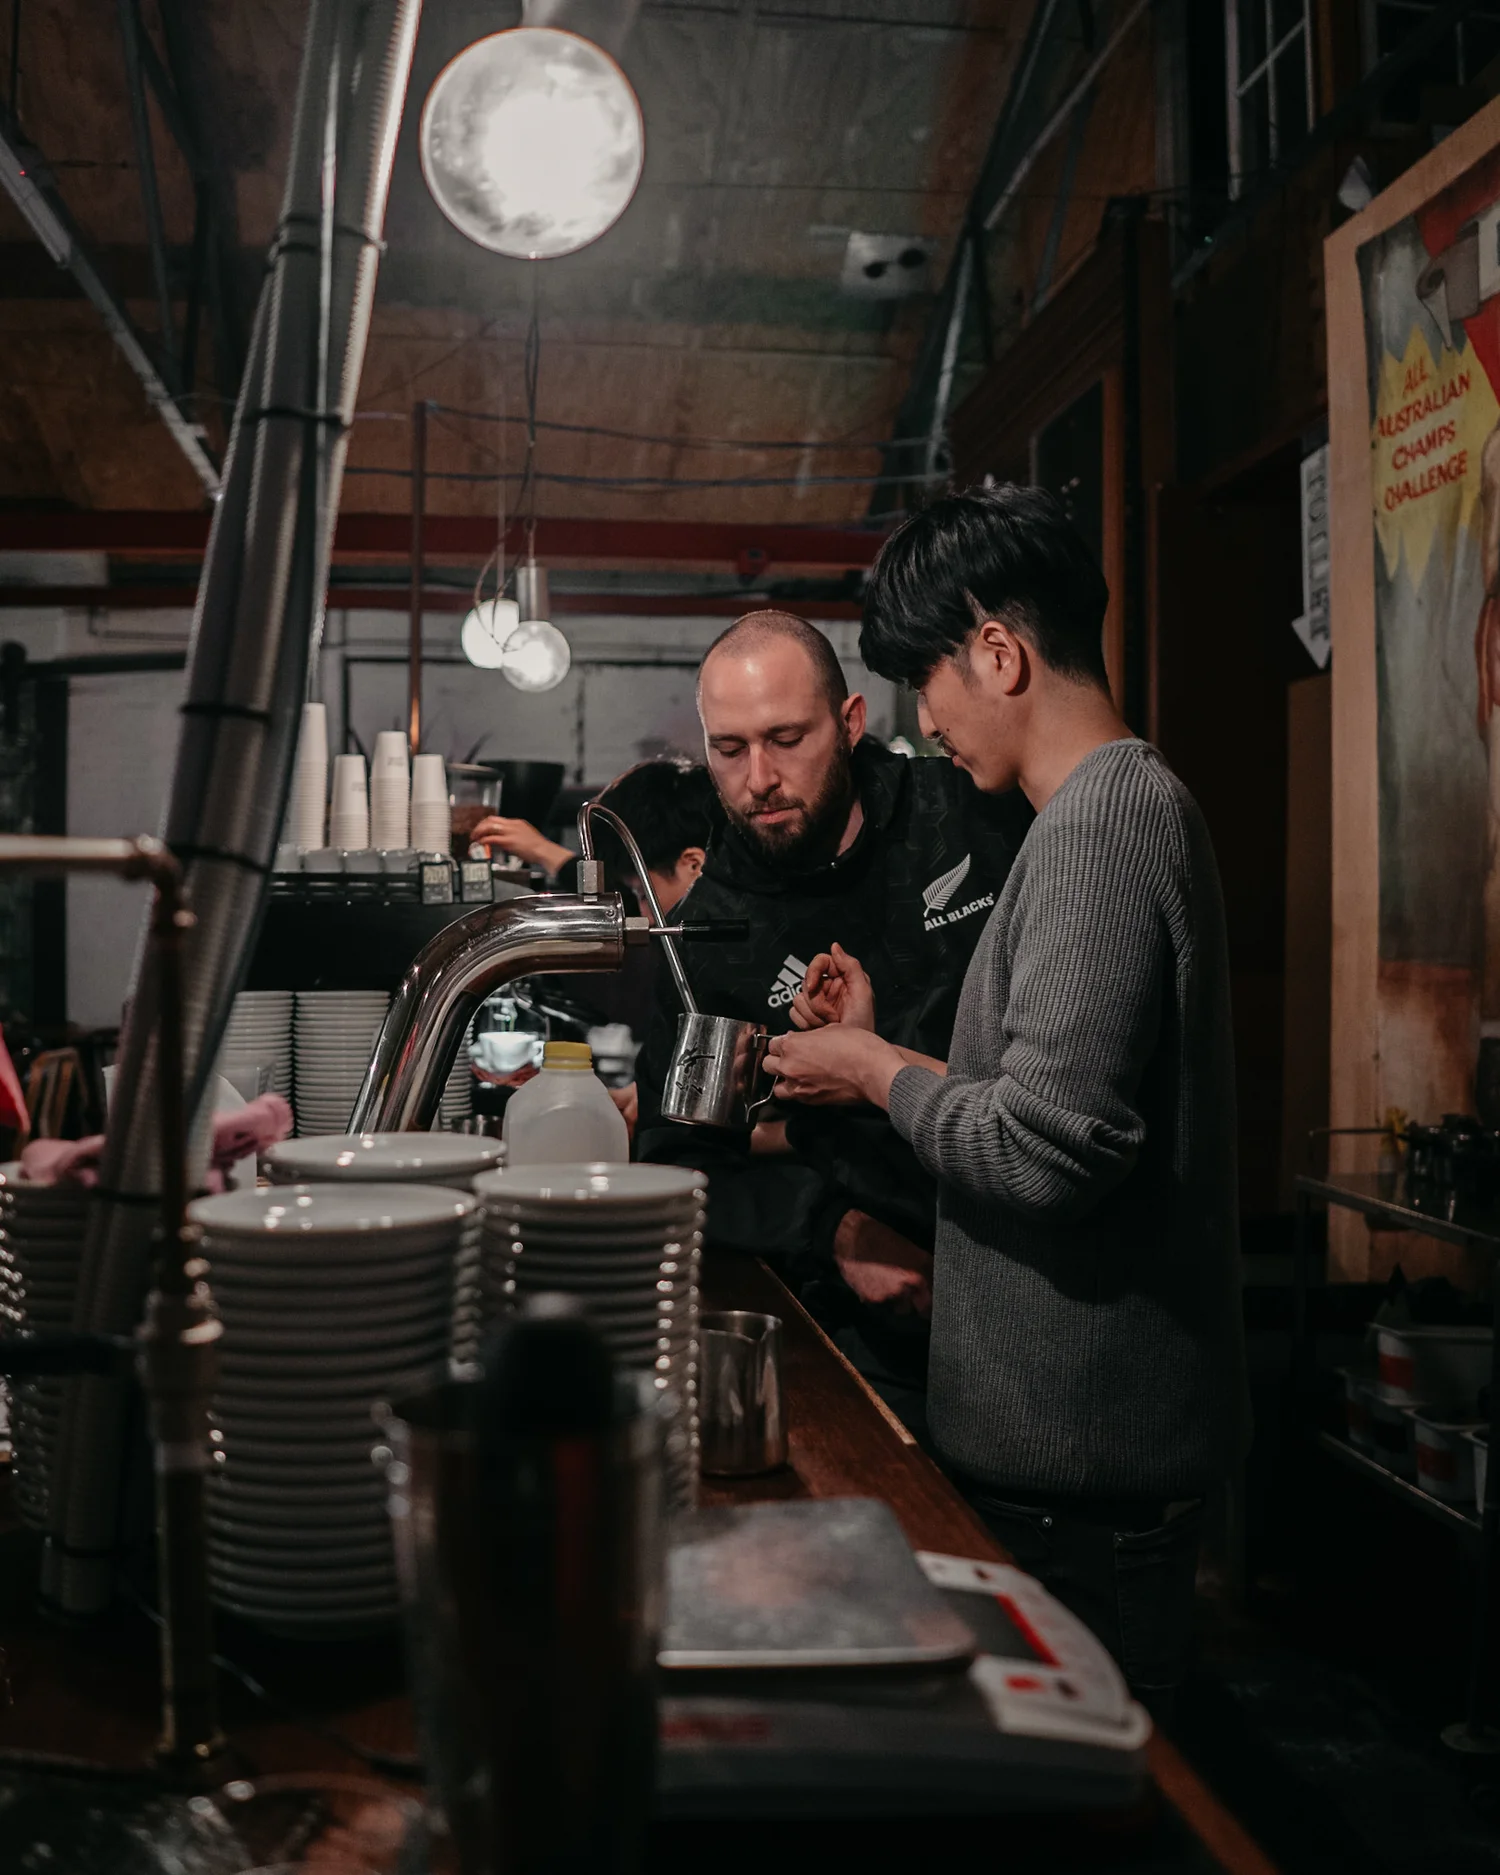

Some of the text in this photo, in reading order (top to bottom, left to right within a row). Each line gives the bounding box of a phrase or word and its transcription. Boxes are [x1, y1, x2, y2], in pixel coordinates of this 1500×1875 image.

[1402, 356, 1428, 397] ALL
[1378, 369, 1471, 437] AUSTRALIAN
[1392, 419, 1456, 470] CHAMPS
[1384, 449, 1468, 511] CHALLENGE
[923, 915, 948, 932] ALL
[767, 984, 803, 1008] adi
